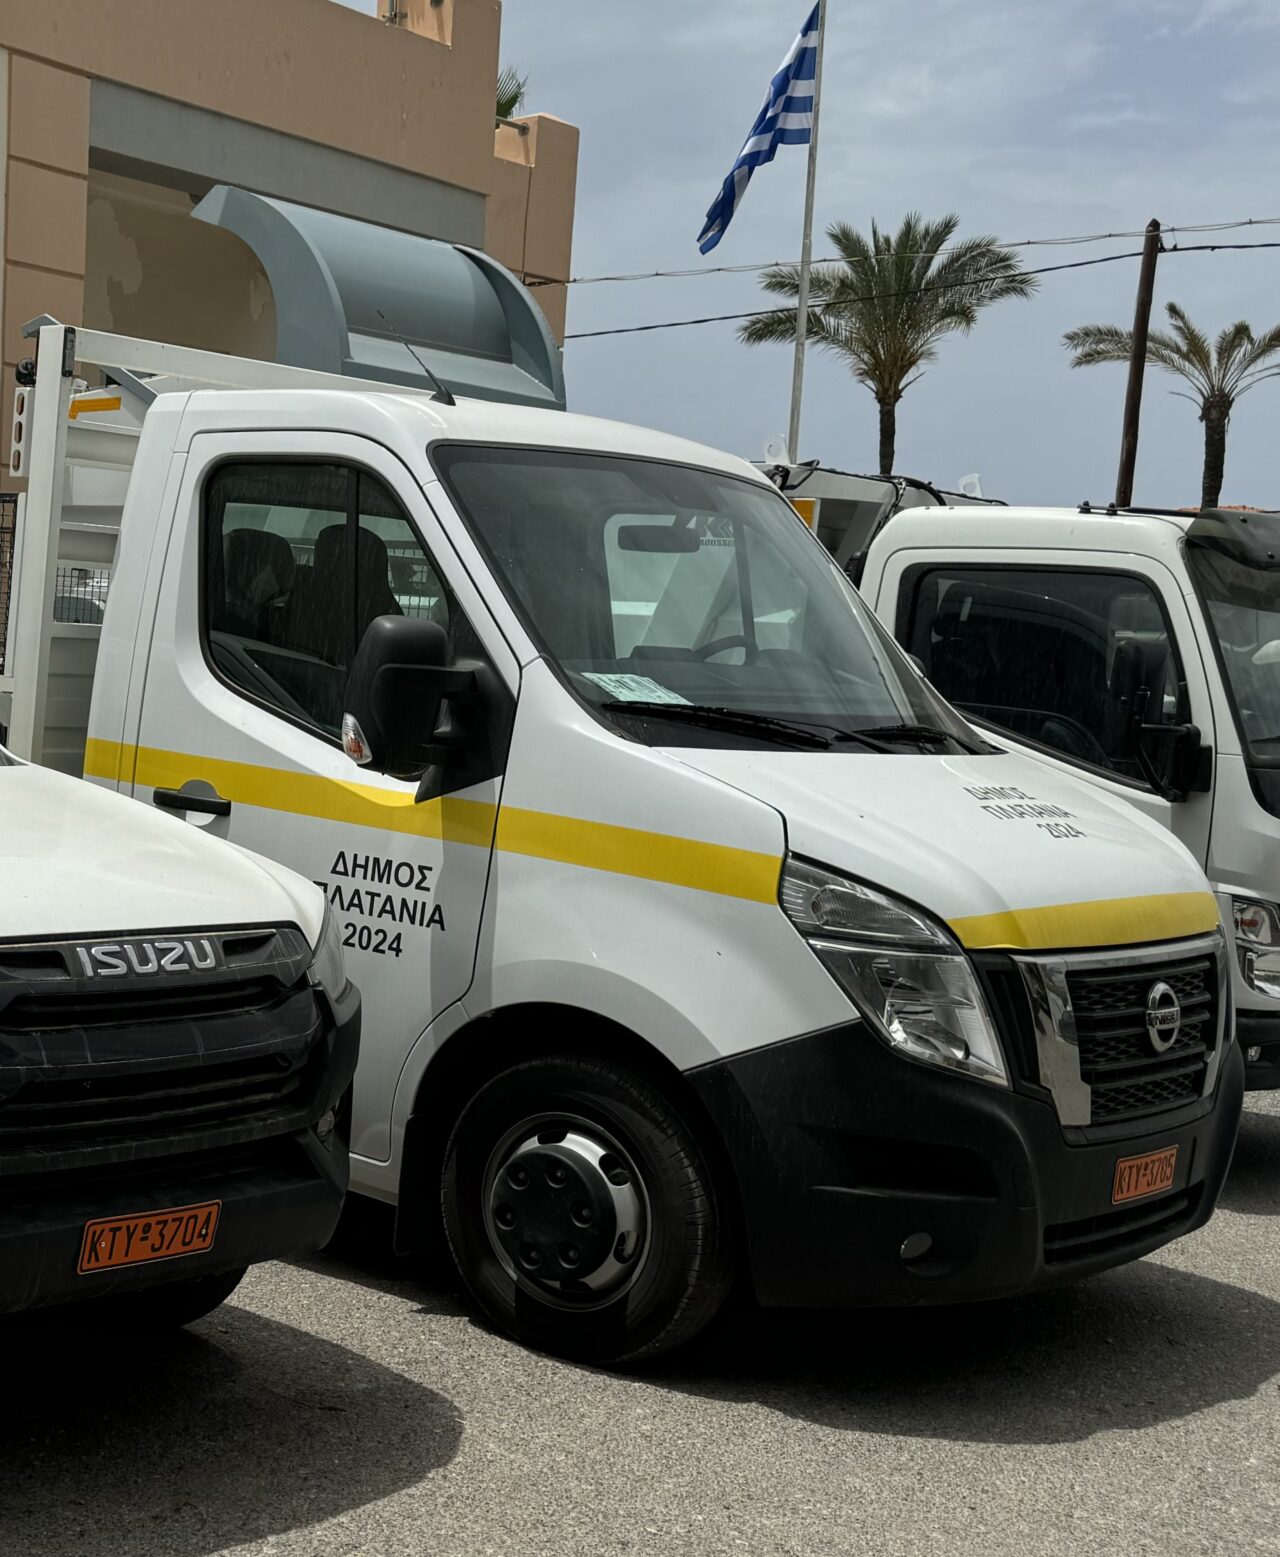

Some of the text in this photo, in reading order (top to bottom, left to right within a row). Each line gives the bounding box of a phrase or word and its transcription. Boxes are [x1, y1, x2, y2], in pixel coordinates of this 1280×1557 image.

[1036, 822, 1088, 838] 2024
[330, 851, 433, 892] ΔΗΜΟΣ
[342, 922, 403, 957] 2024
[76, 939, 216, 977] ISUZU
